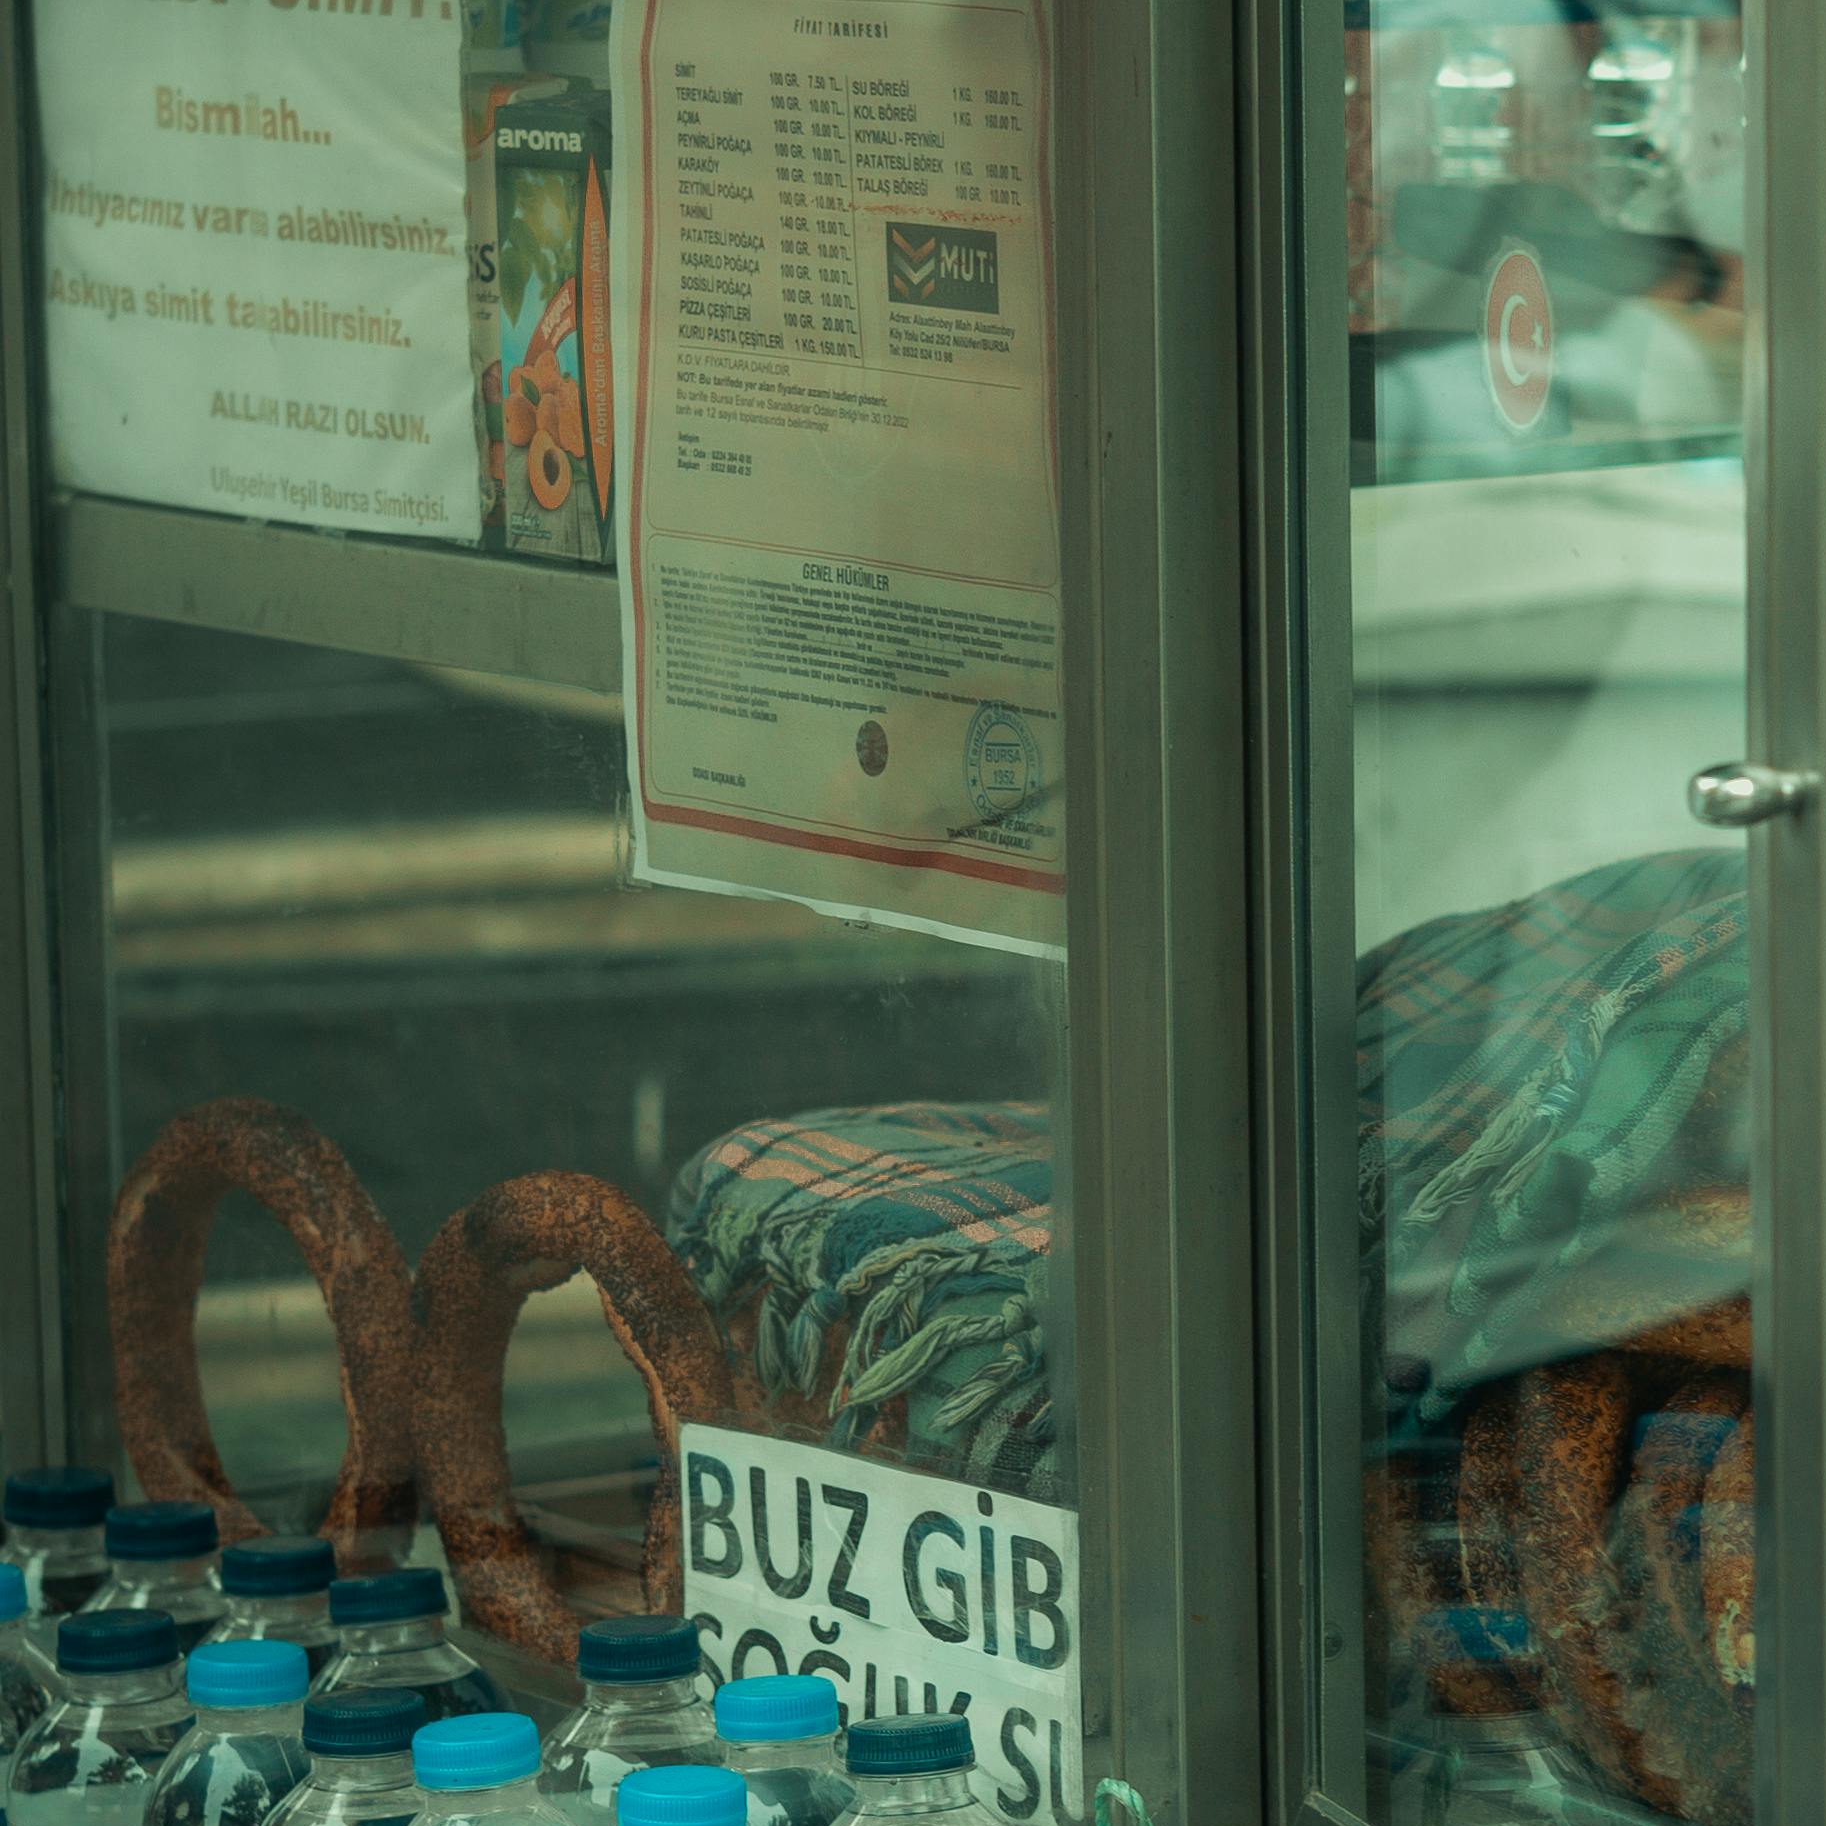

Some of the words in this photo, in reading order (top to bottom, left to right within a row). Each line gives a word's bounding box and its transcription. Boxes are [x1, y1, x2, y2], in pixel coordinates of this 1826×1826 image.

[793, 17, 823, 35] FİYAT
[827, 18, 889, 39] TARİFESİ
[852, 80, 867, 95] SU
[869, 78, 910, 97] BÖREĞİ
[853, 105, 876, 120] KOL
[877, 103, 917, 122] BÖREĞİ
[497, 125, 583, 154] aroma
[716, 134, 752, 155] POĞAÇA
[856, 153, 911, 171] PATATESLİ
[913, 154, 943, 173] BÖREK
[717, 182, 755, 203] POĞAÇA
[857, 177, 890, 197] TALAŞ
[892, 177, 929, 197] BÖREĞİ
[276, 204, 456, 258] alabilirsiniz.
[680, 226, 727, 247] PATATESLİ
[728, 231, 766, 254] POĞAÇA
[723, 254, 760, 277] POĞAÇA
[48, 268, 137, 321] Askıya
[144, 282, 214, 326] simit
[716, 278, 753, 300] POĞAÇA
[680, 297, 704, 317] PİZZA
[707, 300, 752, 323] ÇEŞİTLERİ
[678, 324, 705, 342] KURU
[707, 327, 738, 345] PASTA
[739, 330, 785, 351] ÇEŞİTLERİ
[285, 399, 340, 433] RAZI
[344, 409, 431, 446] OLSUN.
[279, 477, 319, 512] Yeşil
[321, 481, 370, 515] Bursa
[374, 488, 450, 526] Simitçisi.
[802, 562, 833, 581] GENEL
[836, 564, 890, 593] HÜKÜMLER
[985, 747, 1021, 764] BURSA
[687, 1450, 871, 1620] BUZ
[902, 1491, 1071, 1671] GİB
